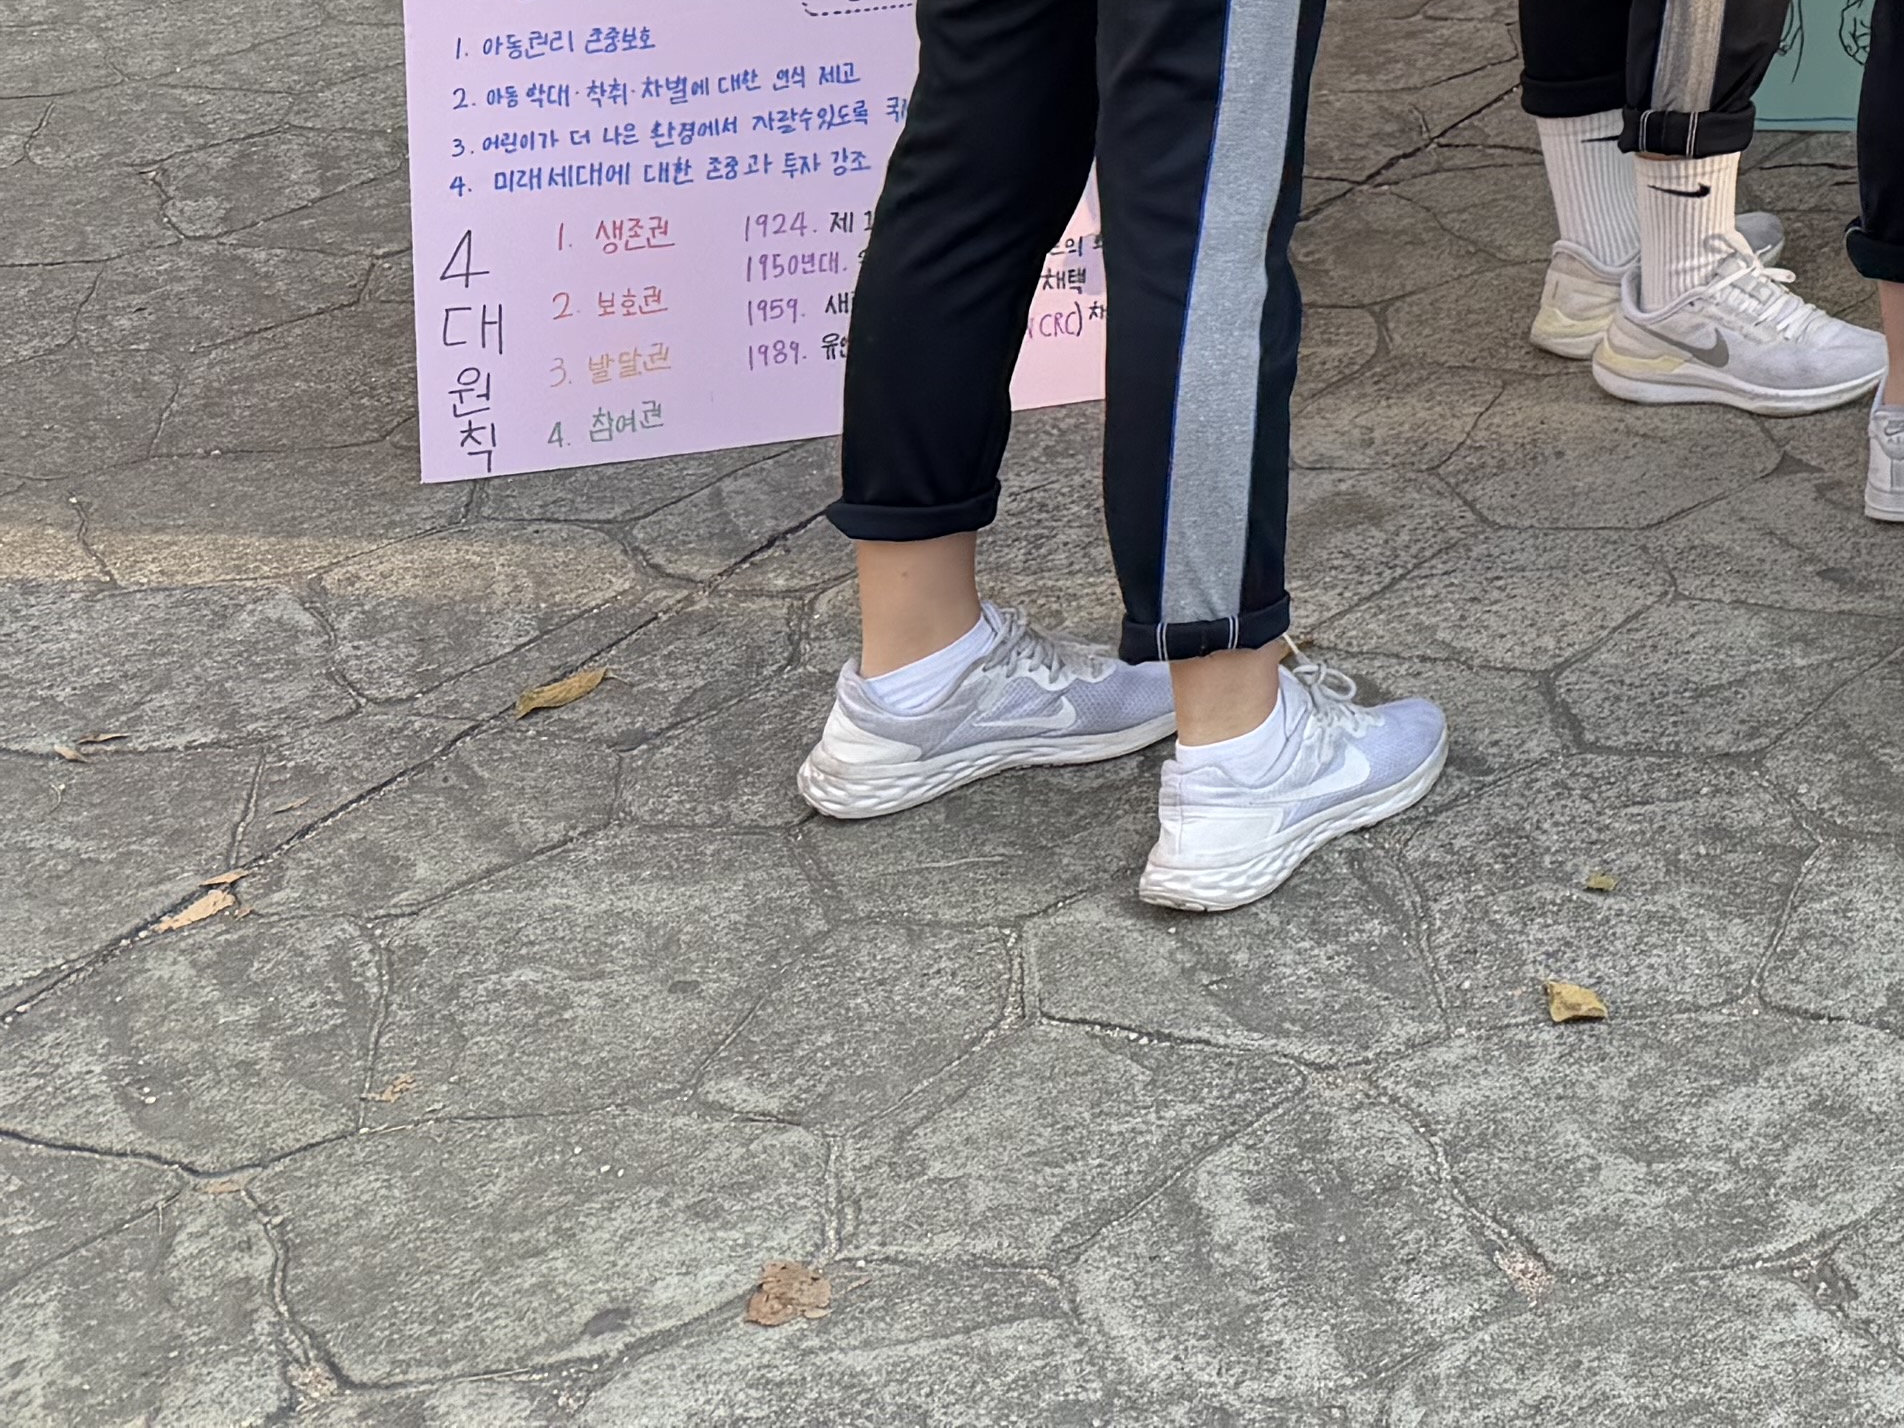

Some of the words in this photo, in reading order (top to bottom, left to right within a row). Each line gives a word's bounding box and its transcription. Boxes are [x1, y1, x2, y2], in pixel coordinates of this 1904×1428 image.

[482, 129, 559, 154] 어린이가
[570, 129, 591, 146] 더
[603, 123, 640, 145] 나은
[644, 157, 694, 185] 대한
[782, 152, 821, 179] 투자
[831, 147, 871, 177] 강조
[556, 222, 573, 251] 1.
[598, 285, 669, 318] 보호권
[588, 343, 672, 384] 발달권
[589, 399, 664, 444] 참여권
